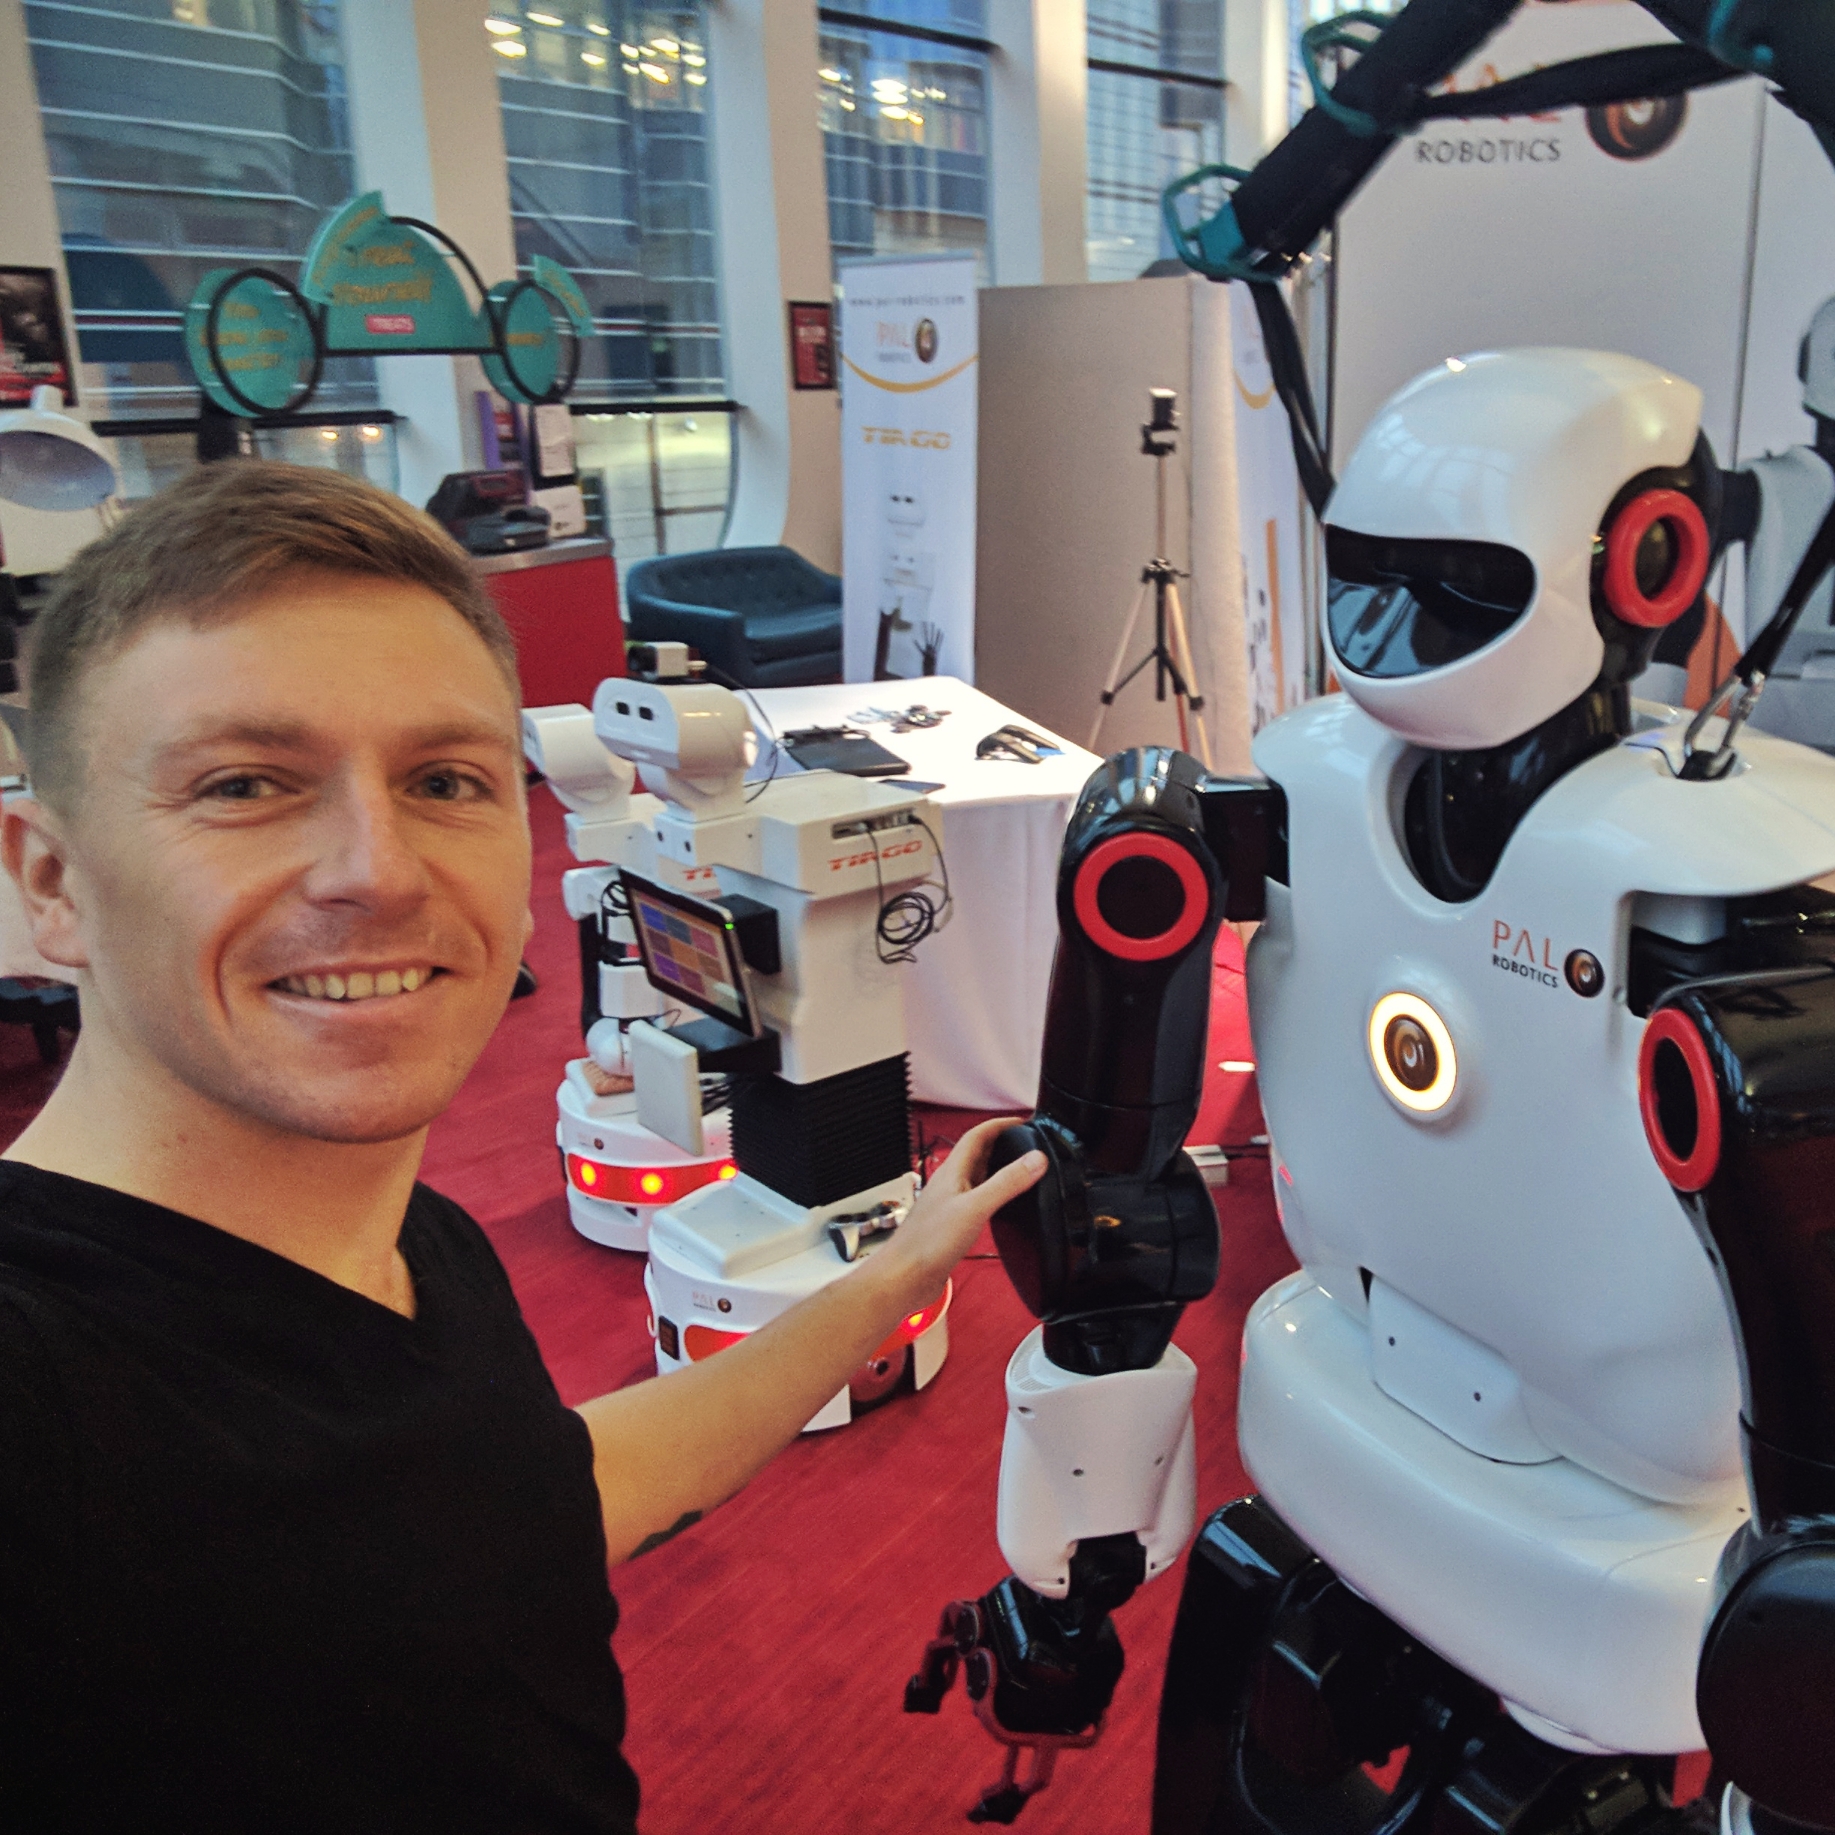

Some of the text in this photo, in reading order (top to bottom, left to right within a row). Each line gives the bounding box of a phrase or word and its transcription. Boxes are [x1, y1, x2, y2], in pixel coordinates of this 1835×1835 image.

[1414, 138, 1562, 164] ROBOTICS
[1491, 918, 1560, 973] PAL
[1491, 953, 1560, 989] ROBOTICS
